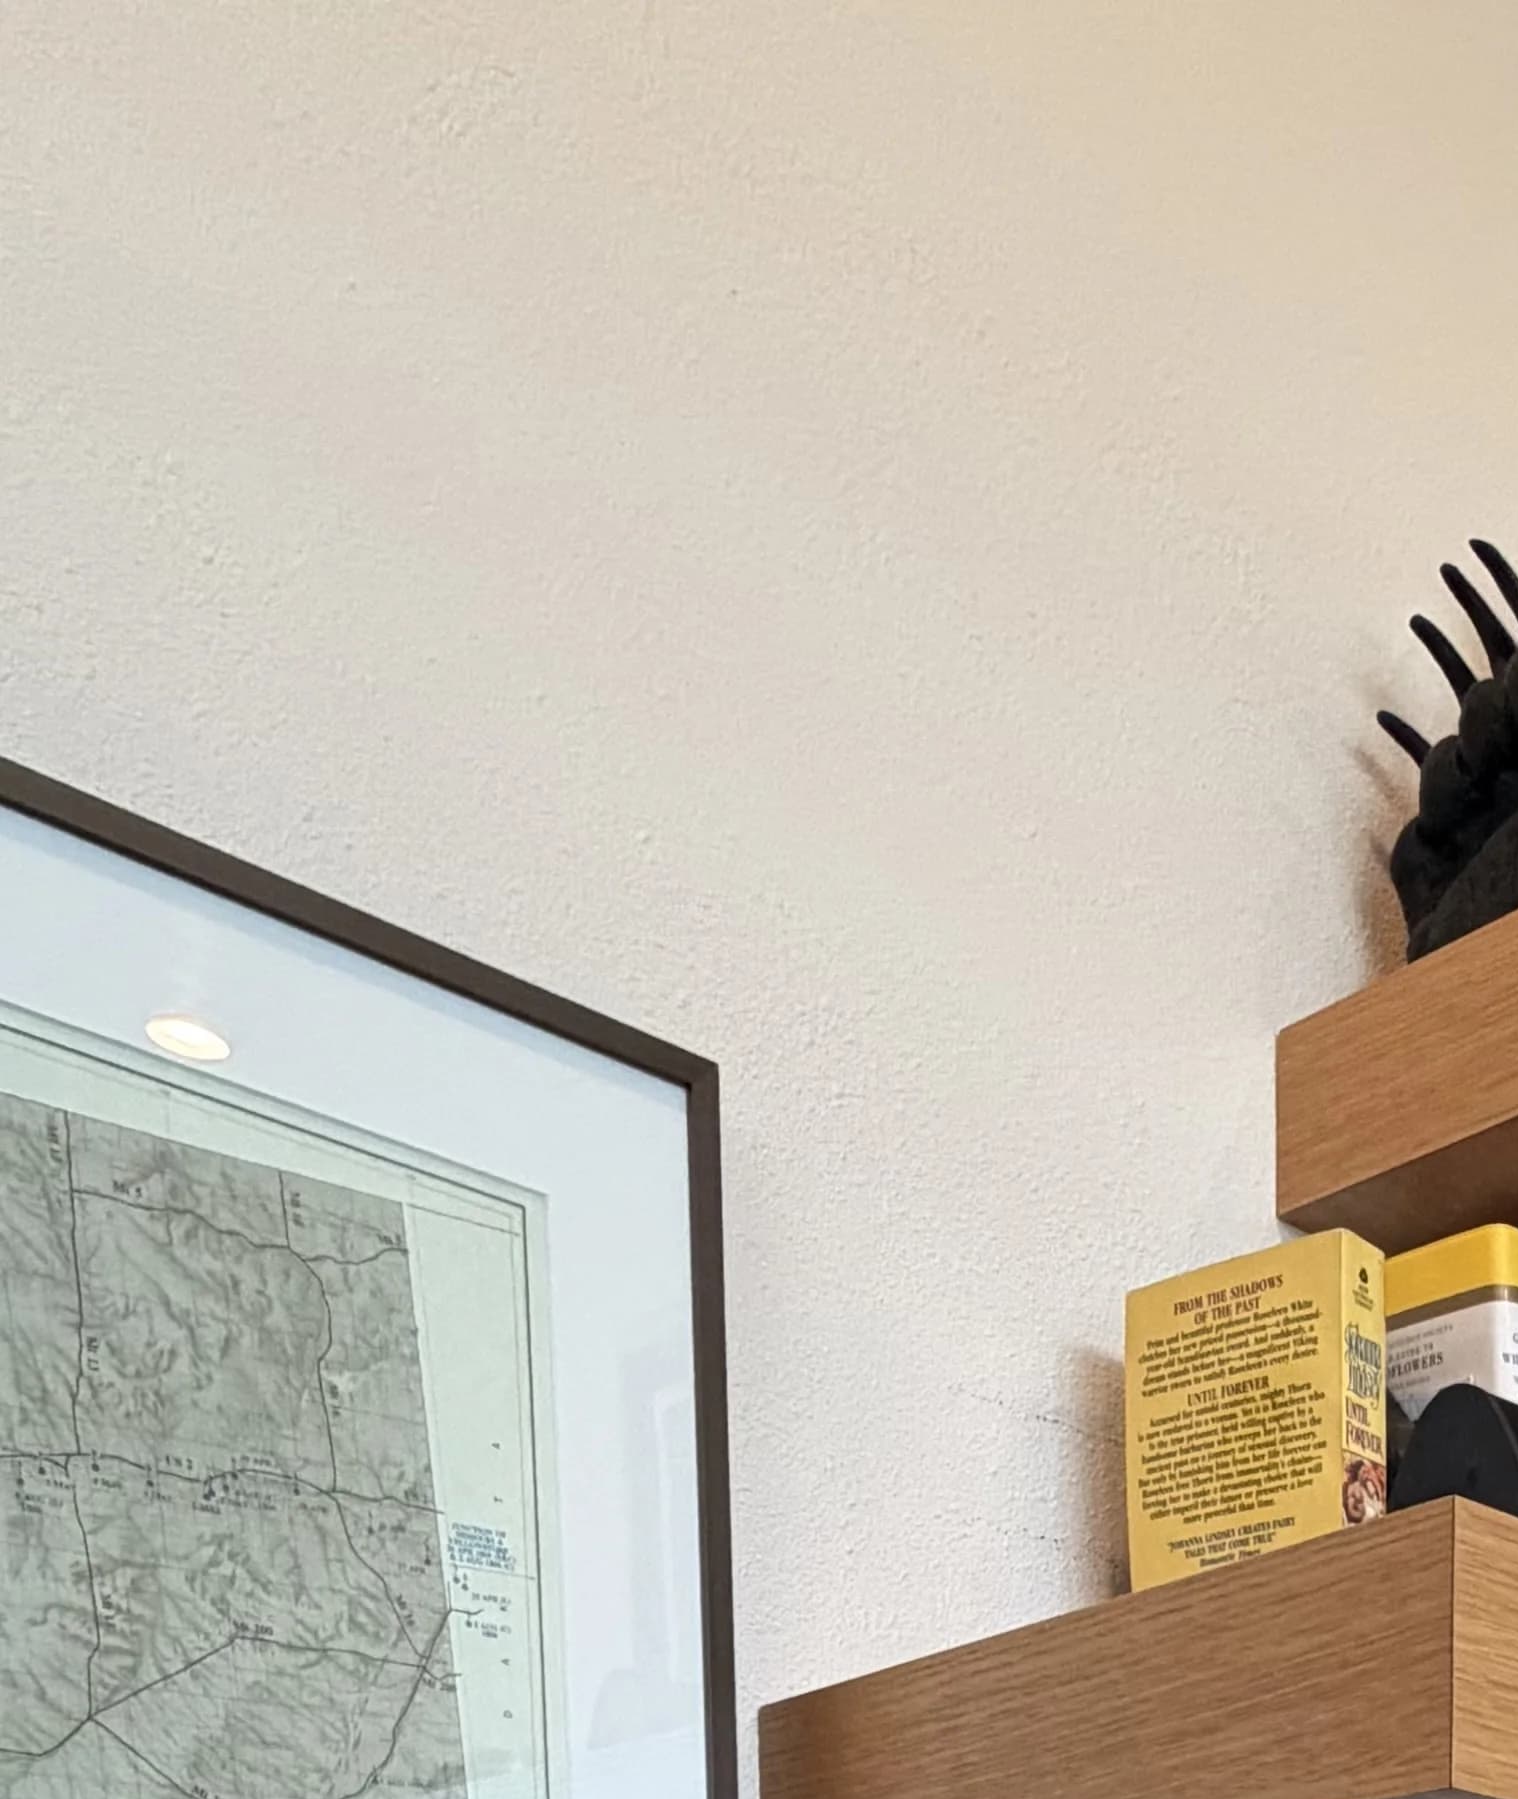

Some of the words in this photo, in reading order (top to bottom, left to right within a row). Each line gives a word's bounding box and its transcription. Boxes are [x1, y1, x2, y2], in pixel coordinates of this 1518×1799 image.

[1174, 1296, 1204, 1315] FROM
[1207, 1289, 1228, 1306] THE
[1230, 1275, 1283, 1299] SHADOWS
[1194, 1310, 1209, 1325] OF
[1212, 1304, 1233, 1320] THE
[1236, 1296, 1261, 1314] PAST
[1188, 1388, 1218, 1406] UNTIL
[1221, 1376, 1270, 1398] FOREVER
[1346, 1399, 1370, 1427] UNTIL
[1346, 1421, 1383, 1457] FOREVER
